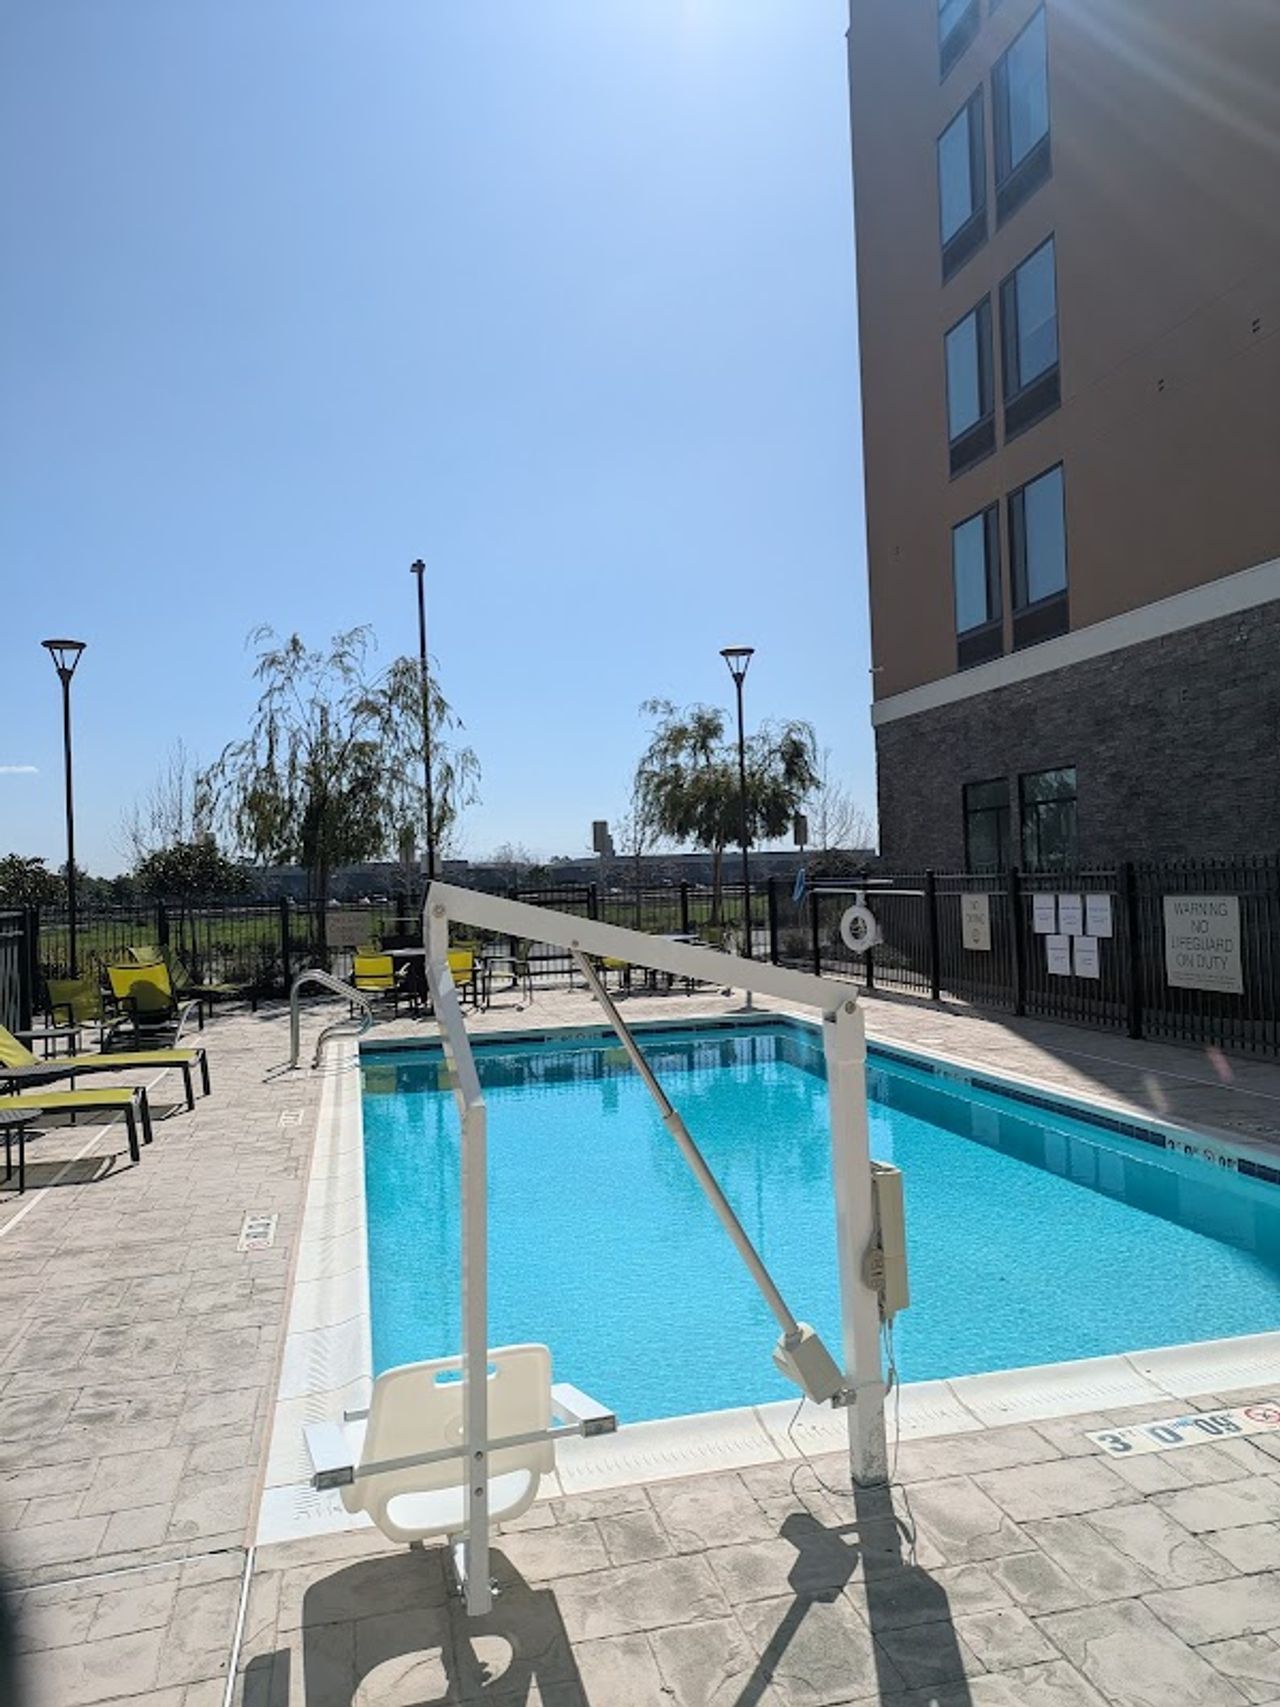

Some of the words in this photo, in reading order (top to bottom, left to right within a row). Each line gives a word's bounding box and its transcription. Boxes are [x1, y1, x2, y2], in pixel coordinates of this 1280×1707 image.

[1174, 902, 1229, 917] WARNING
[1191, 919, 1209, 934] NO
[1171, 936, 1234, 953] LIFEGUARD
[1197, 953, 1228, 970] DUTY
[1098, 1433, 1132, 1452] 3
